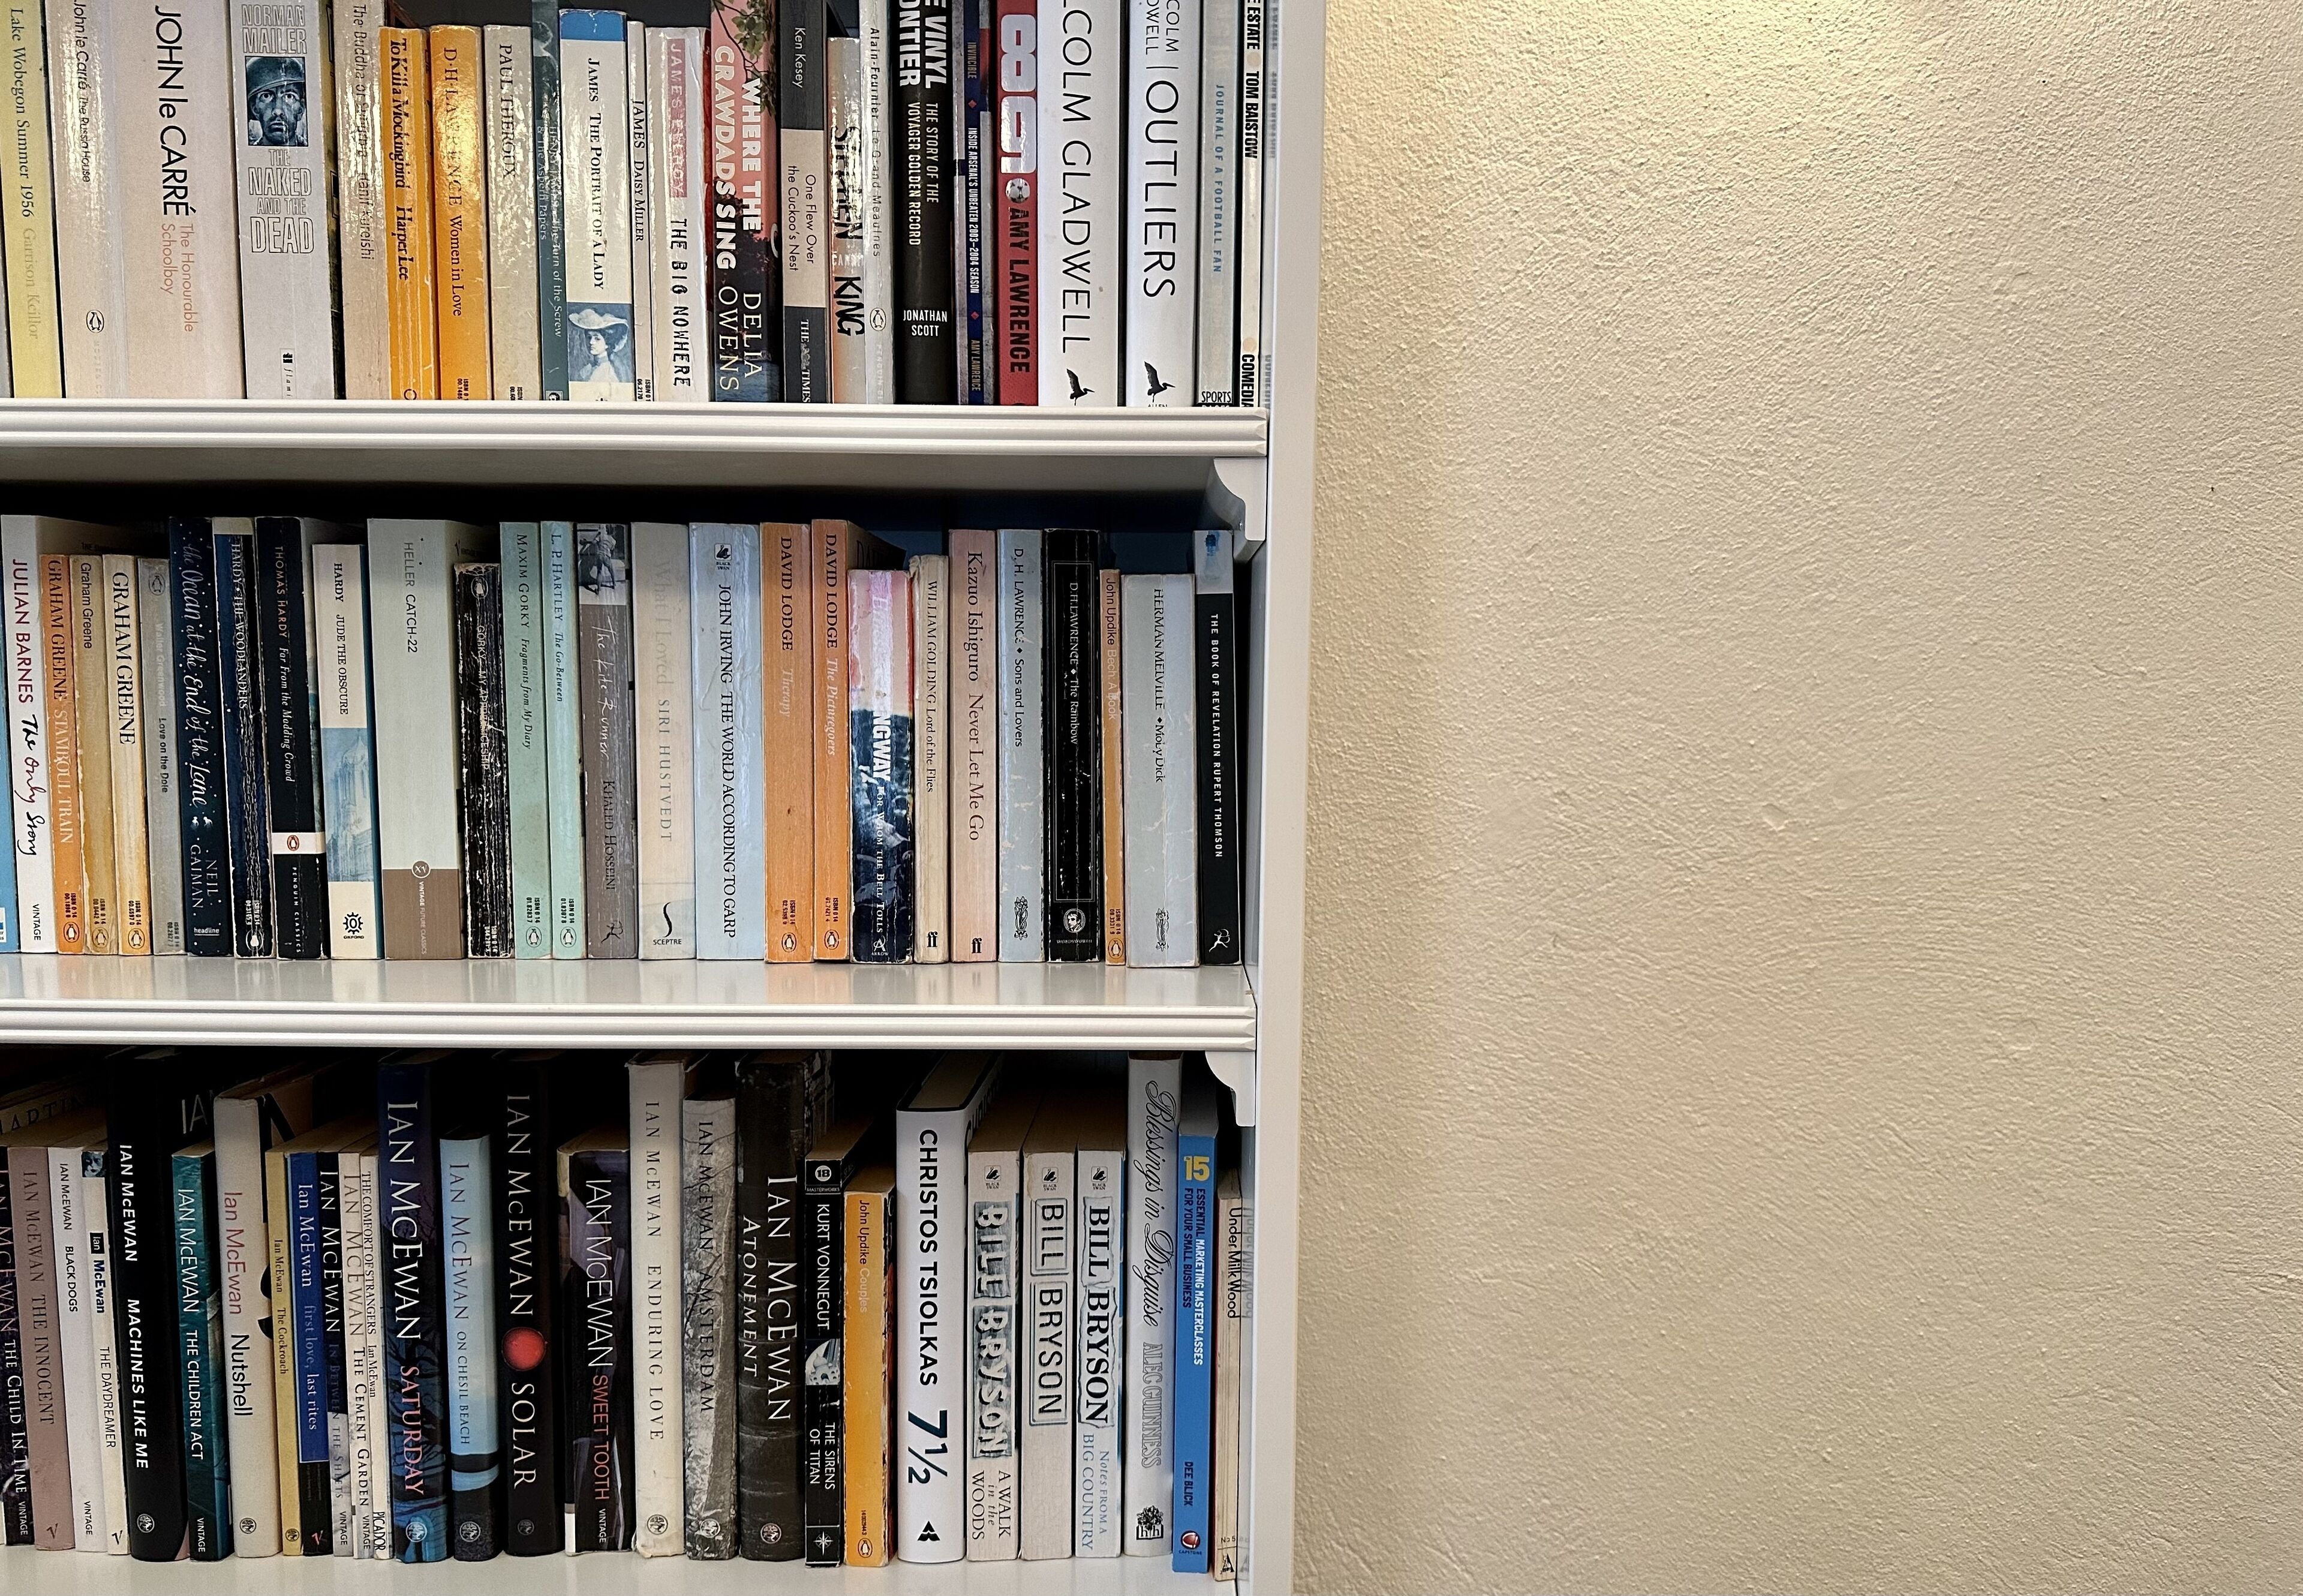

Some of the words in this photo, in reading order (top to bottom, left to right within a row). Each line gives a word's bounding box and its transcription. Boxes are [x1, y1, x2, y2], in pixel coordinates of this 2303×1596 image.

[10, 8, 21, 41] Lake
[242, 4, 306, 27] NORMAN
[155, 6, 182, 89] JOHN
[243, 28, 307, 53] MAILER
[795, 28, 805, 49] Ken
[11, 47, 25, 114] Wobegon
[792, 54, 806, 88] Kesey
[159, 98, 179, 118] le
[714, 46, 735, 195] CRAWDADS
[742, 79, 761, 172] WHERE
[906, 102, 921, 150] VOYAGER
[925, 103, 937, 122] THE
[1215, 85, 1224, 140] JOURNAL
[17, 120, 29, 179] Summer
[269, 150, 291, 166] THE
[925, 128, 938, 161] STORY
[1215, 147, 1223, 161] OF
[160, 125, 196, 216] CARRÉ
[248, 168, 311, 196] NAKED
[788, 166, 799, 182] the
[805, 175, 816, 200] One
[909, 155, 921, 198] GOLDEN
[927, 167, 938, 179] OF
[1143, 80, 1178, 297] OUTLIERS
[20, 185, 33, 218] 1956
[257, 197, 281, 215] AND
[284, 197, 306, 215] THE
[742, 181, 761, 230] THE
[927, 183, 939, 203] THE
[1214, 181, 1222, 243] FOOTBALL
[788, 188, 800, 239] Cuckoo's
[805, 205, 816, 235] Flew
[909, 202, 921, 245] RECORD
[1009, 208, 1029, 251] AMY
[179, 224, 192, 248] The
[251, 217, 314, 253] DEAD
[450, 215, 462, 265] Women
[671, 219, 687, 250] THE
[716, 204, 736, 269] SING
[807, 235, 816, 263] Over
[22, 228, 34, 287] Garrison
[160, 224, 175, 294] Schoolboy
[452, 269, 464, 281] in
[789, 244, 799, 270] Nest
[180, 248, 194, 332] Honourable
[671, 261, 687, 294] BIG
[28, 294, 38, 339] Keillor
[452, 284, 464, 316] Love
[903, 310, 947, 322] JONATHAN
[1009, 260, 1030, 372] LAWRENCE
[672, 306, 690, 386] NOWHERE
[718, 287, 739, 390] OWENS
[744, 293, 762, 377] DELIA
[912, 325, 939, 336] SCOTT
[275, 546, 285, 594] THOMAS
[334, 563, 343, 602] HARDY
[404, 542, 415, 587] HELLER
[967, 552, 982, 605] Kazuo
[13, 560, 29, 624] JULIAN
[718, 585, 732, 626] JOHN
[113, 572, 131, 661] GRAHAM
[277, 601, 287, 638] HARDY
[336, 615, 345, 641] JUDE
[406, 594, 417, 653] CATCH-22
[279, 648, 288, 662] Far
[337, 644, 346, 665] THE
[720, 631, 732, 684] IRVING
[963, 611, 984, 682] Ishiguro
[16, 633, 34, 703] BARNES
[281, 665, 290, 689] From
[1212, 674, 1219, 686] OF
[116, 665, 136, 744] GREENE
[338, 667, 348, 715] OBSCURE
[721, 692, 733, 723] THE
[22, 714, 38, 750] The
[281, 710, 292, 749] Madding
[659, 699, 670, 734] SIRI
[969, 694, 984, 744] Never
[1212, 691, 1220, 756] REVELATION
[284, 752, 295, 782] Crowd
[722, 726, 736, 782] WORLD
[969, 750, 984, 778] Let
[14, 756, 46, 803] Only
[659, 745, 672, 841] HUSTVEDT
[969, 783, 984, 809] Me
[17, 811, 45, 855] Story
[722, 785, 736, 873] ACCORDING
[969, 815, 984, 840] Go
[724, 877, 736, 895] TO
[32, 904, 41, 940] VINTAGE
[724, 898, 736, 938] GARP
[507, 1095, 531, 1155] IAN
[60, 1164, 68, 1182] IAN
[120, 1145, 133, 1176] IAN
[61, 1185, 72, 1230] McEWAN
[224, 1192, 242, 1220] Ian
[586, 1180, 611, 1224] IAN
[919, 1129, 938, 1253] CHRISTOS
[1184, 1188, 1193, 1207] FOR
[122, 1183, 137, 1261] McEWAN
[817, 1204, 829, 1239] KURT
[1183, 1208, 1193, 1230] YOUR
[1196, 1189, 1205, 1237] ESSENTIAL
[1228, 1207, 1241, 1248] Under
[92, 1236, 101, 1251] Ian
[508, 1170, 533, 1315] McEWAN
[1041, 1204, 1064, 1267] BILL
[1089, 1206, 1110, 1277] BILL
[1183, 1233, 1193, 1261] SMALL
[65, 1246, 75, 1279] BLACK
[226, 1229, 246, 1314] McEwan
[1195, 1239, 1205, 1287] MARKETING
[1228, 1252, 1241, 1284] Milk
[67, 1282, 77, 1312] DOGS
[94, 1260, 105, 1313] McEwan
[586, 1237, 613, 1367] McEWAN
[817, 1245, 829, 1330] VONNEGUT
[1183, 1264, 1192, 1308] BUSINESS
[1228, 1285, 1241, 1318] Wood
[919, 1261, 938, 1385] TSIOLKAS
[1193, 1290, 1205, 1366] MASTERCLASSES
[100, 1346, 110, 1370] THE
[128, 1299, 144, 1394] MACHINES
[1039, 1288, 1063, 1414] BRYSON
[1086, 1290, 1109, 1423] BRYSON
[231, 1334, 252, 1416] Nutshell
[101, 1373, 116, 1448] DAYDREAMER
[133, 1400, 148, 1437] LIKE
[593, 1375, 609, 1435] SWEET
[512, 1382, 536, 1490] SOLAR
[810, 1429, 820, 1445] OF
[825, 1423, 835, 1448] THE
[1083, 1434, 1094, 1462] BIG
[135, 1444, 149, 1468] ME
[594, 1441, 610, 1500] TOOTH
[810, 1448, 820, 1484] TITAN
[825, 1451, 835, 1490] SIRENS
[1099, 1451, 1109, 1484] Notes
[1184, 1462, 1193, 1480] DEE
[1082, 1466, 1094, 1550] COUNTRY
[1099, 1488, 1108, 1523] FROM
[1183, 1481, 1193, 1506] BLICK
[83, 1501, 93, 1535] VINTAGE
